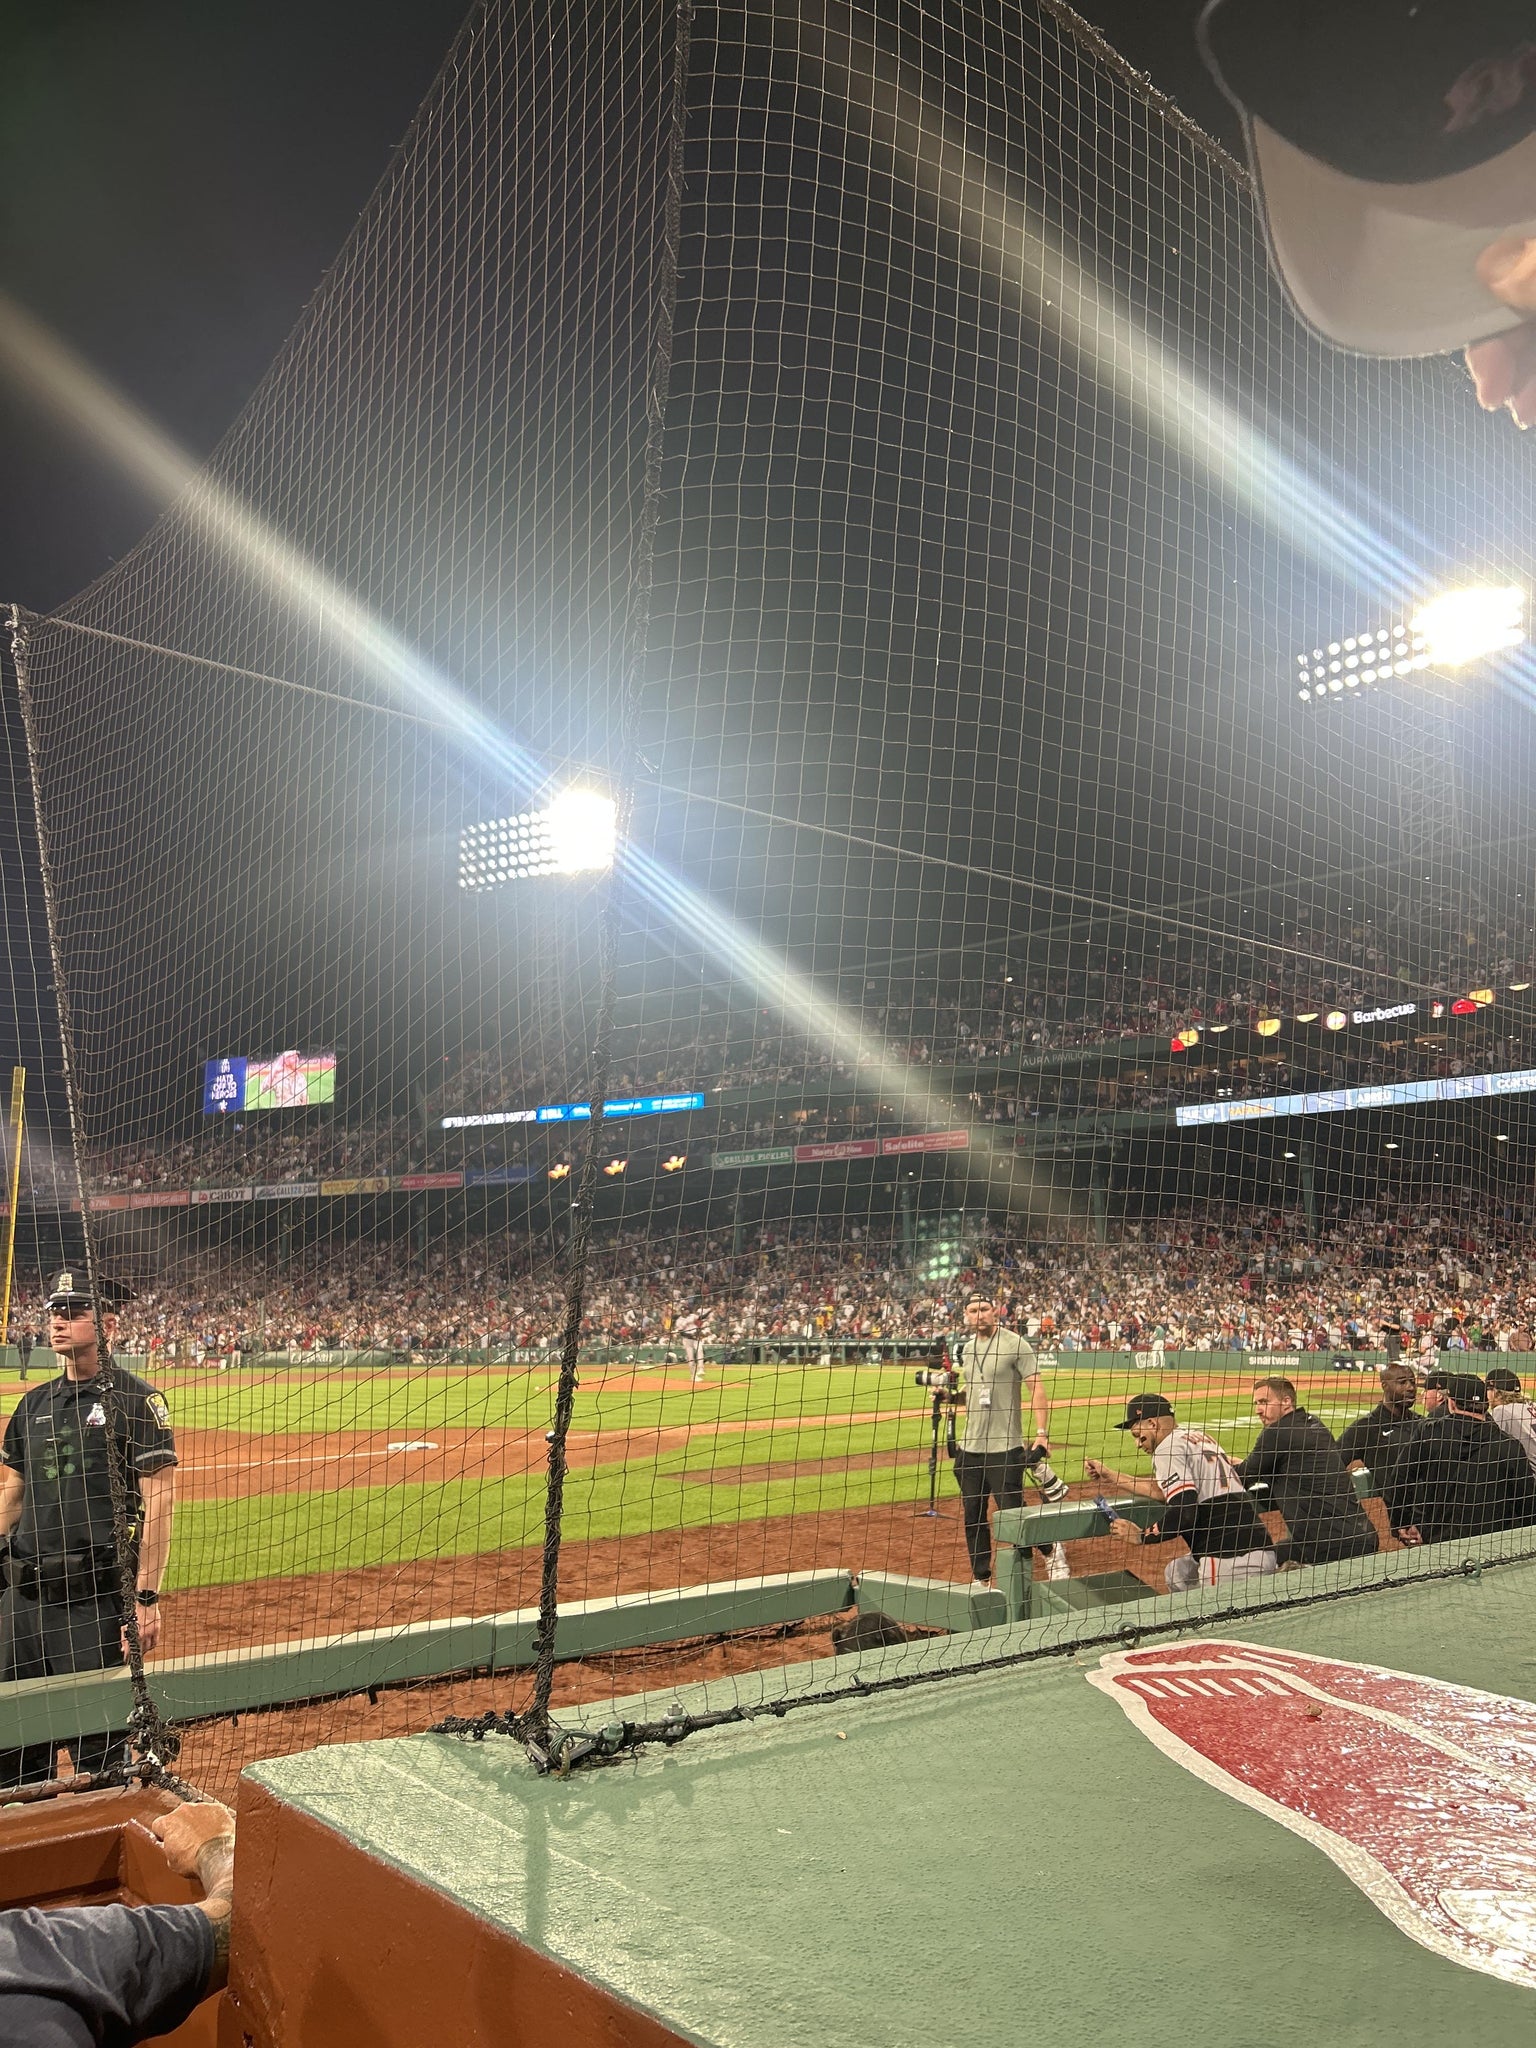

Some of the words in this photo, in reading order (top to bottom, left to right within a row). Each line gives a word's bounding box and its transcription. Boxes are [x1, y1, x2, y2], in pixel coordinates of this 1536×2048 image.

[1353, 1003, 1416, 1024] Barbecue
[1358, 1090, 1391, 1103] ABREU
[885, 1139, 924, 1151] Safelite
[758, 1151, 789, 1162] PICKLES
[1248, 1355, 1300, 1367] smartwater
